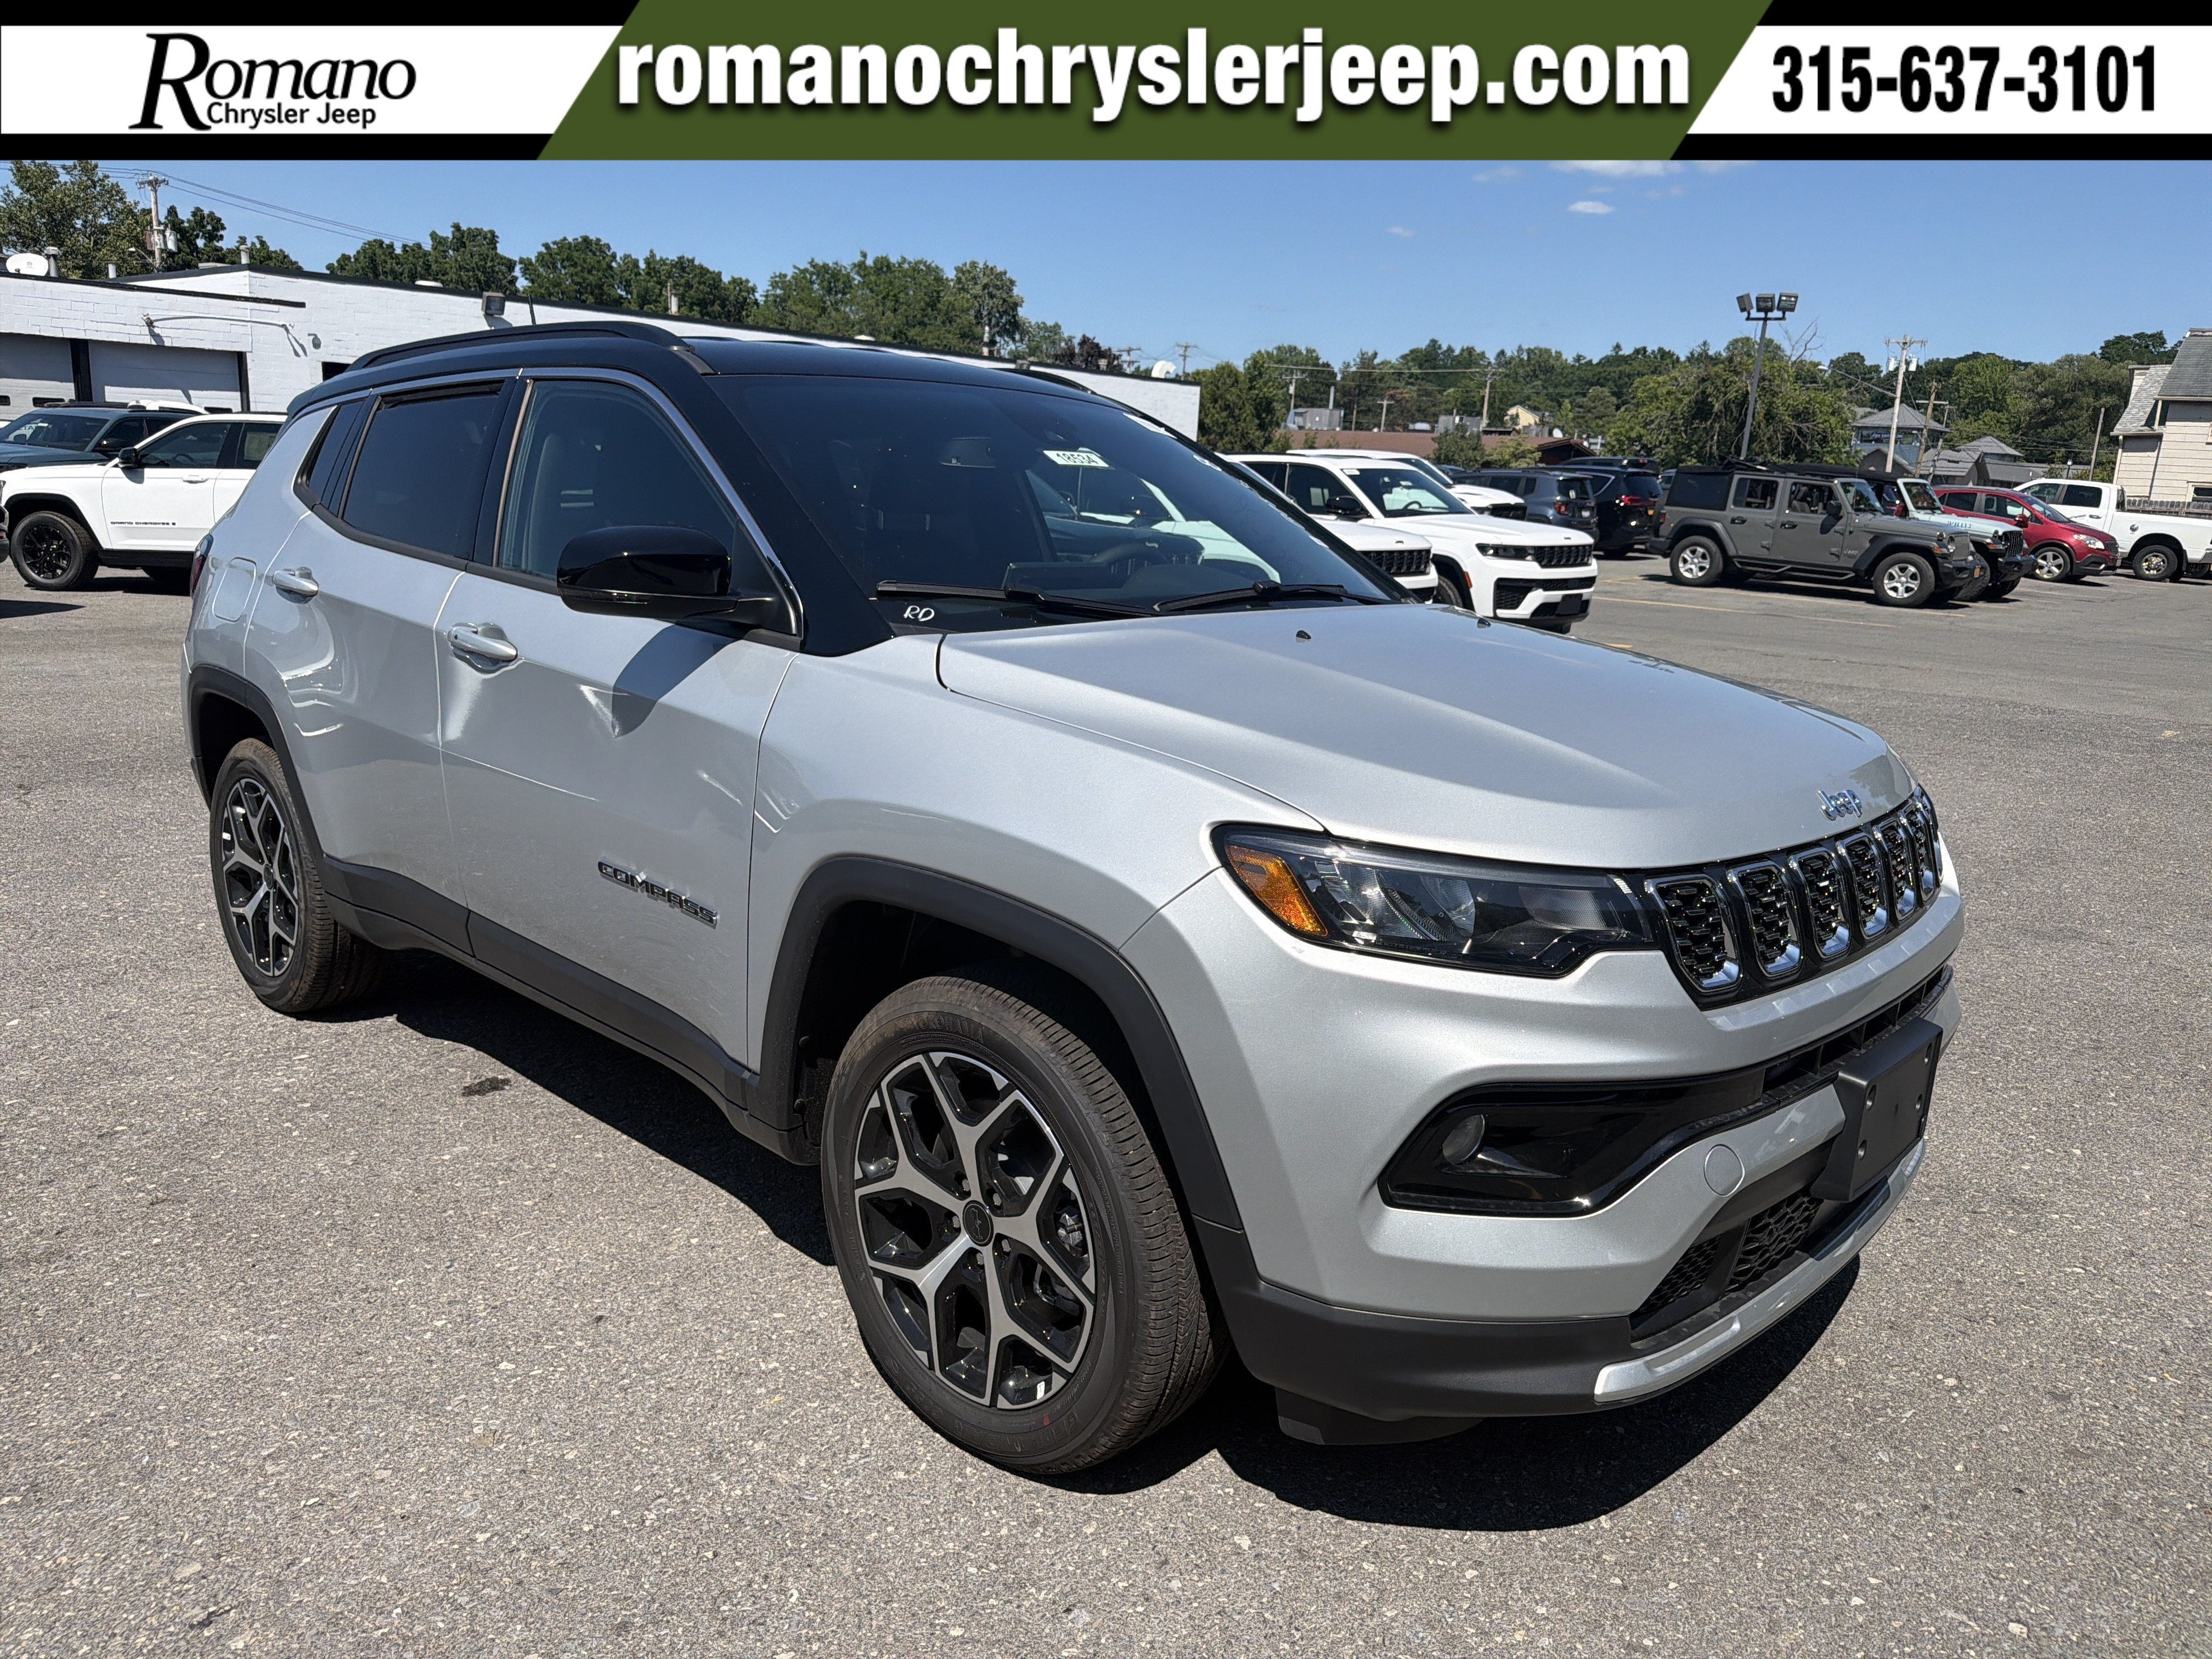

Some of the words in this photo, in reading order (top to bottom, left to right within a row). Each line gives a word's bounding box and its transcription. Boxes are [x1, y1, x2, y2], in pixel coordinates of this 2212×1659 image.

[1056, 453, 1099, 465] 18534
[1816, 789, 1863, 821] Jeep
[597, 860, 719, 926] COMPASS
[910, 1014, 985, 1045] YOKOHAMA
